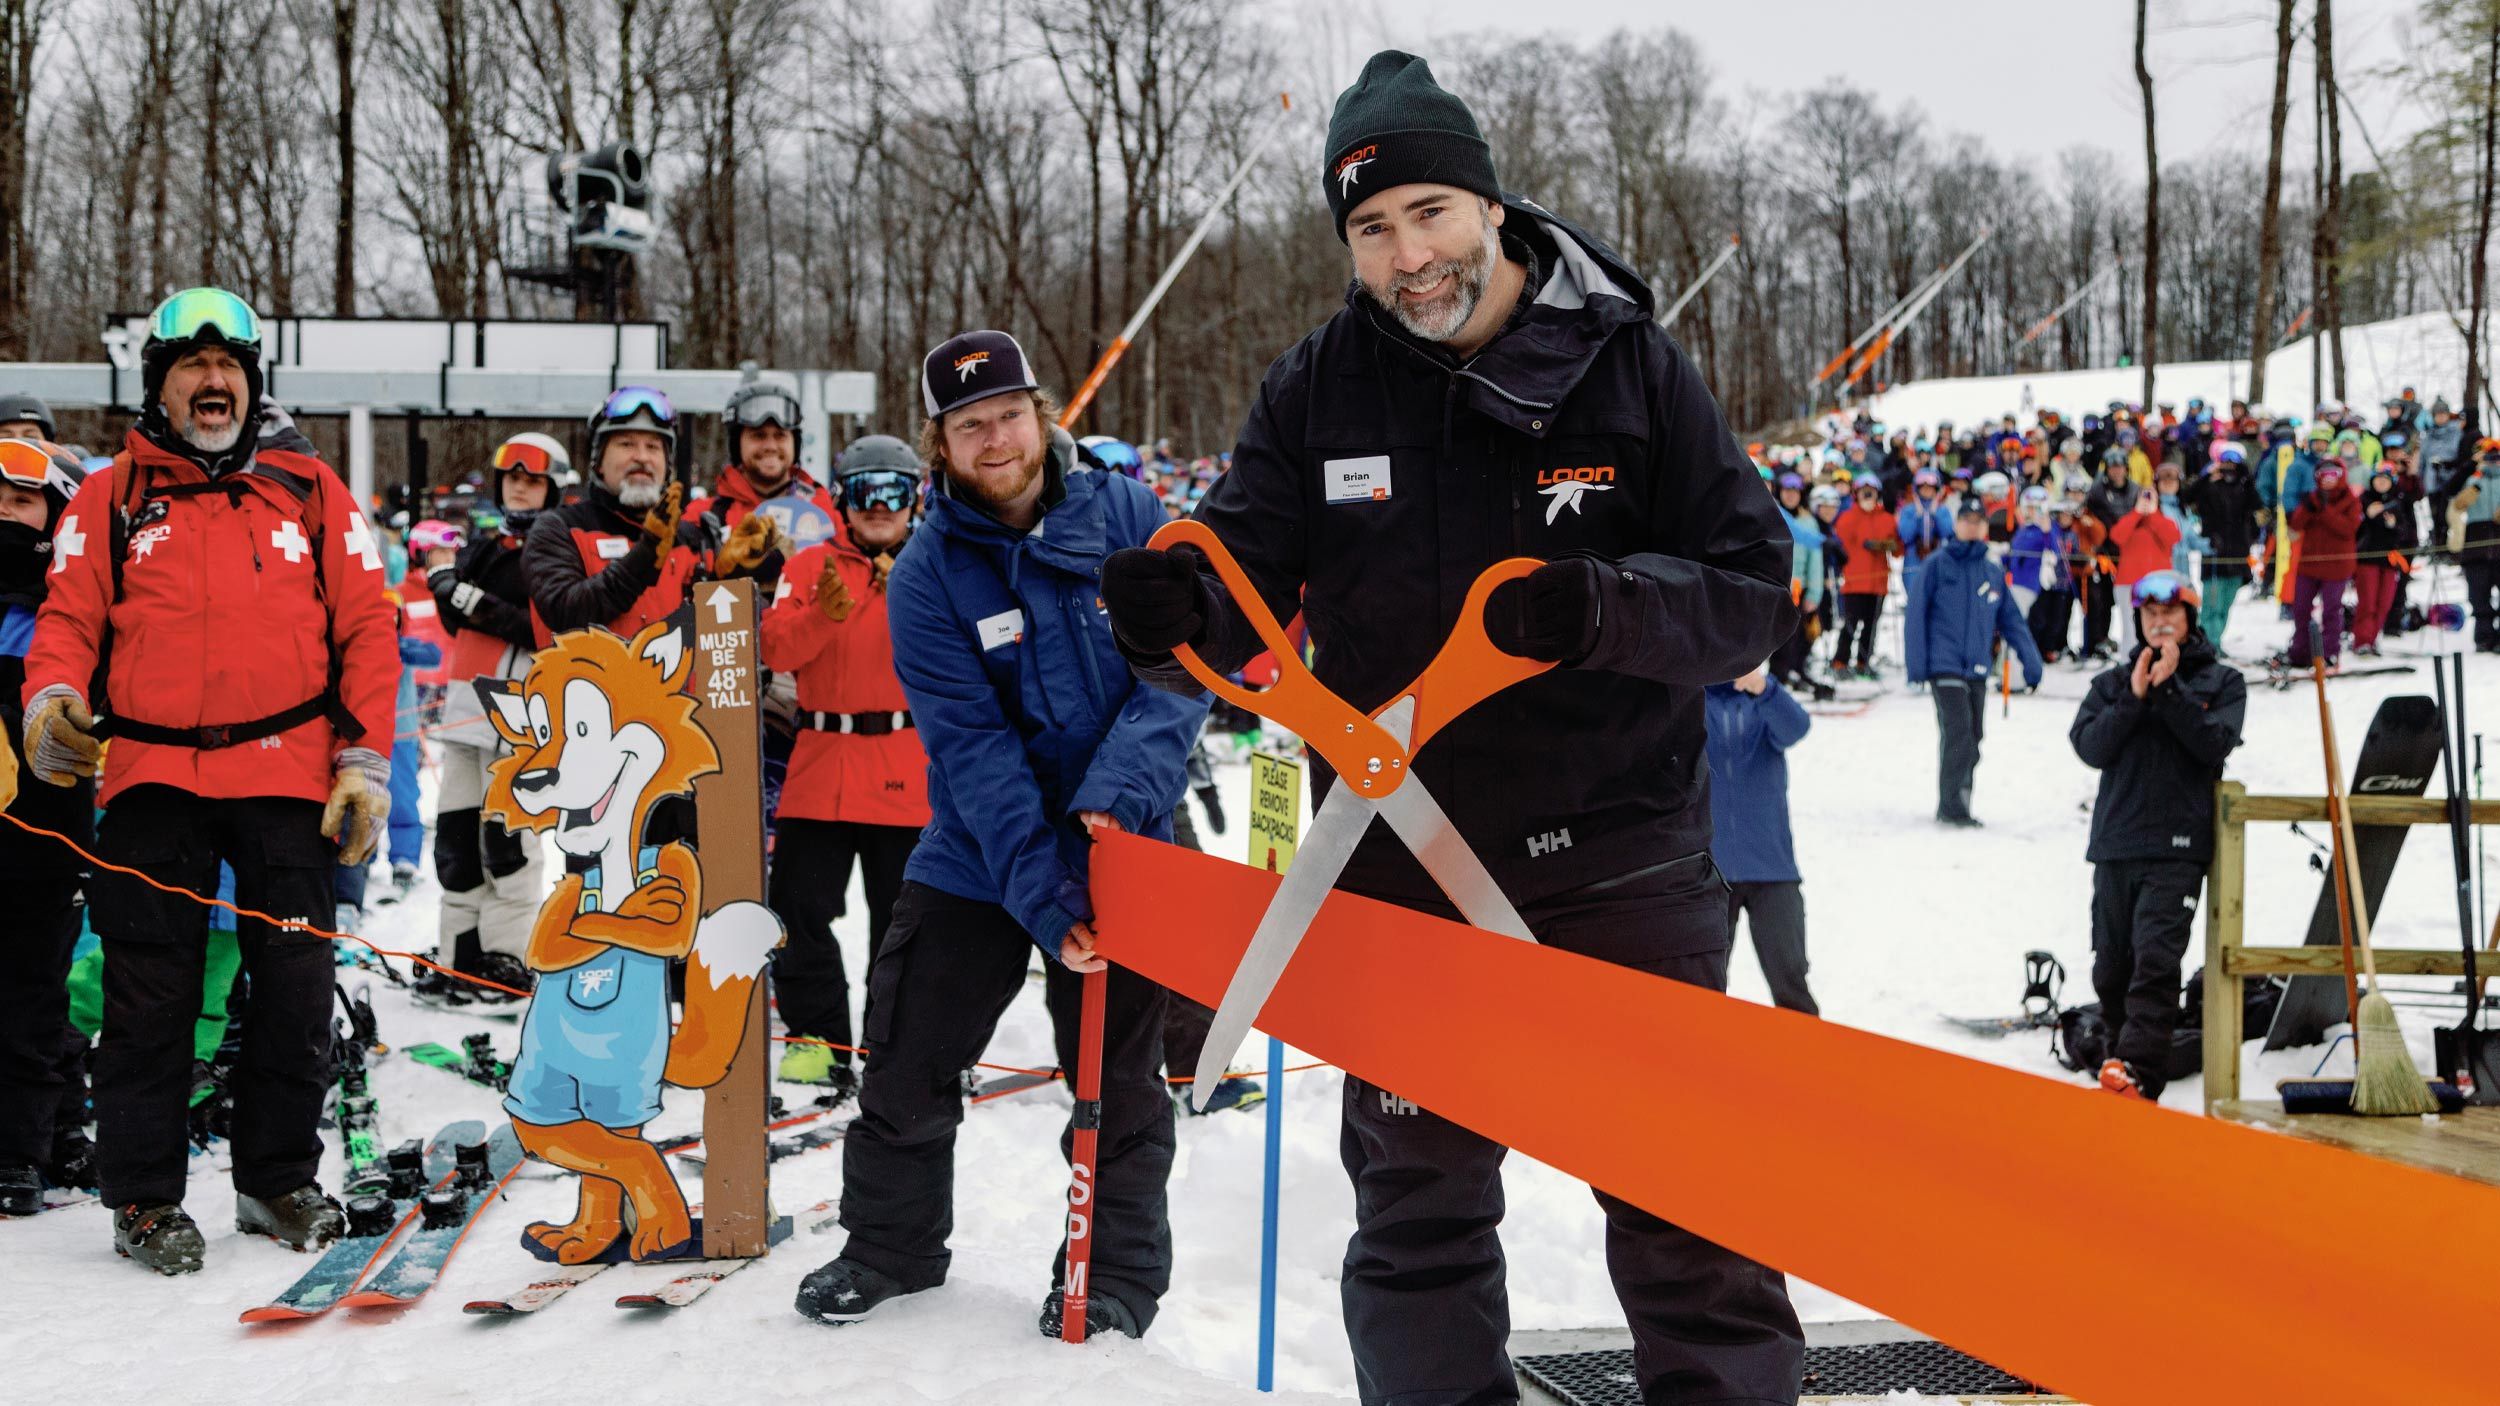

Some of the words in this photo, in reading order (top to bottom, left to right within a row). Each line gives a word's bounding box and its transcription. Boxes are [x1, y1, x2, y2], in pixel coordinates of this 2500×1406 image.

[1343, 472, 1370, 482] Brian
[699, 630, 749, 651] MUST
[711, 648, 737, 667] BE
[707, 690, 751, 709] TALL
[1262, 765, 1288, 791] PLEASE
[1260, 789, 1289, 817] REMOVE
[1251, 810, 1294, 844] BACKPACKS
[1526, 827, 1573, 858] HH
